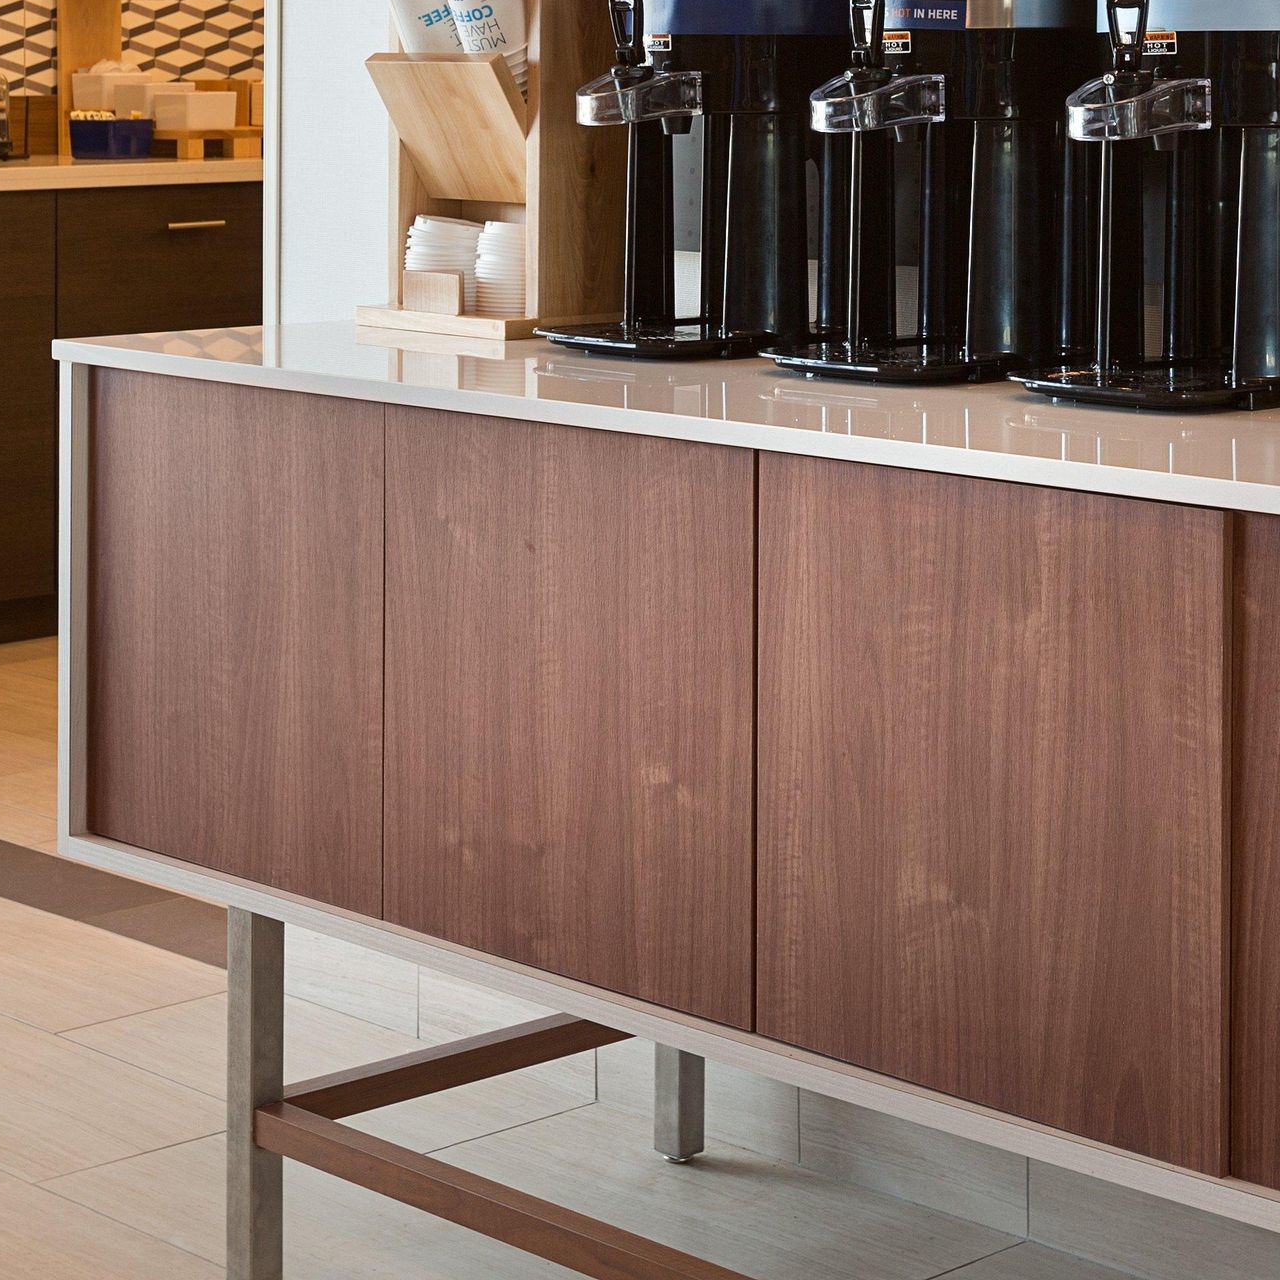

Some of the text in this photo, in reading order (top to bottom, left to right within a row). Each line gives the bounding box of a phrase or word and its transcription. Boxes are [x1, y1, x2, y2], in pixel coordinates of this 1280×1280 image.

[890, 8, 911, 18] HOT
[913, 8, 925, 19] IN
[927, 8, 958, 20] HERE
